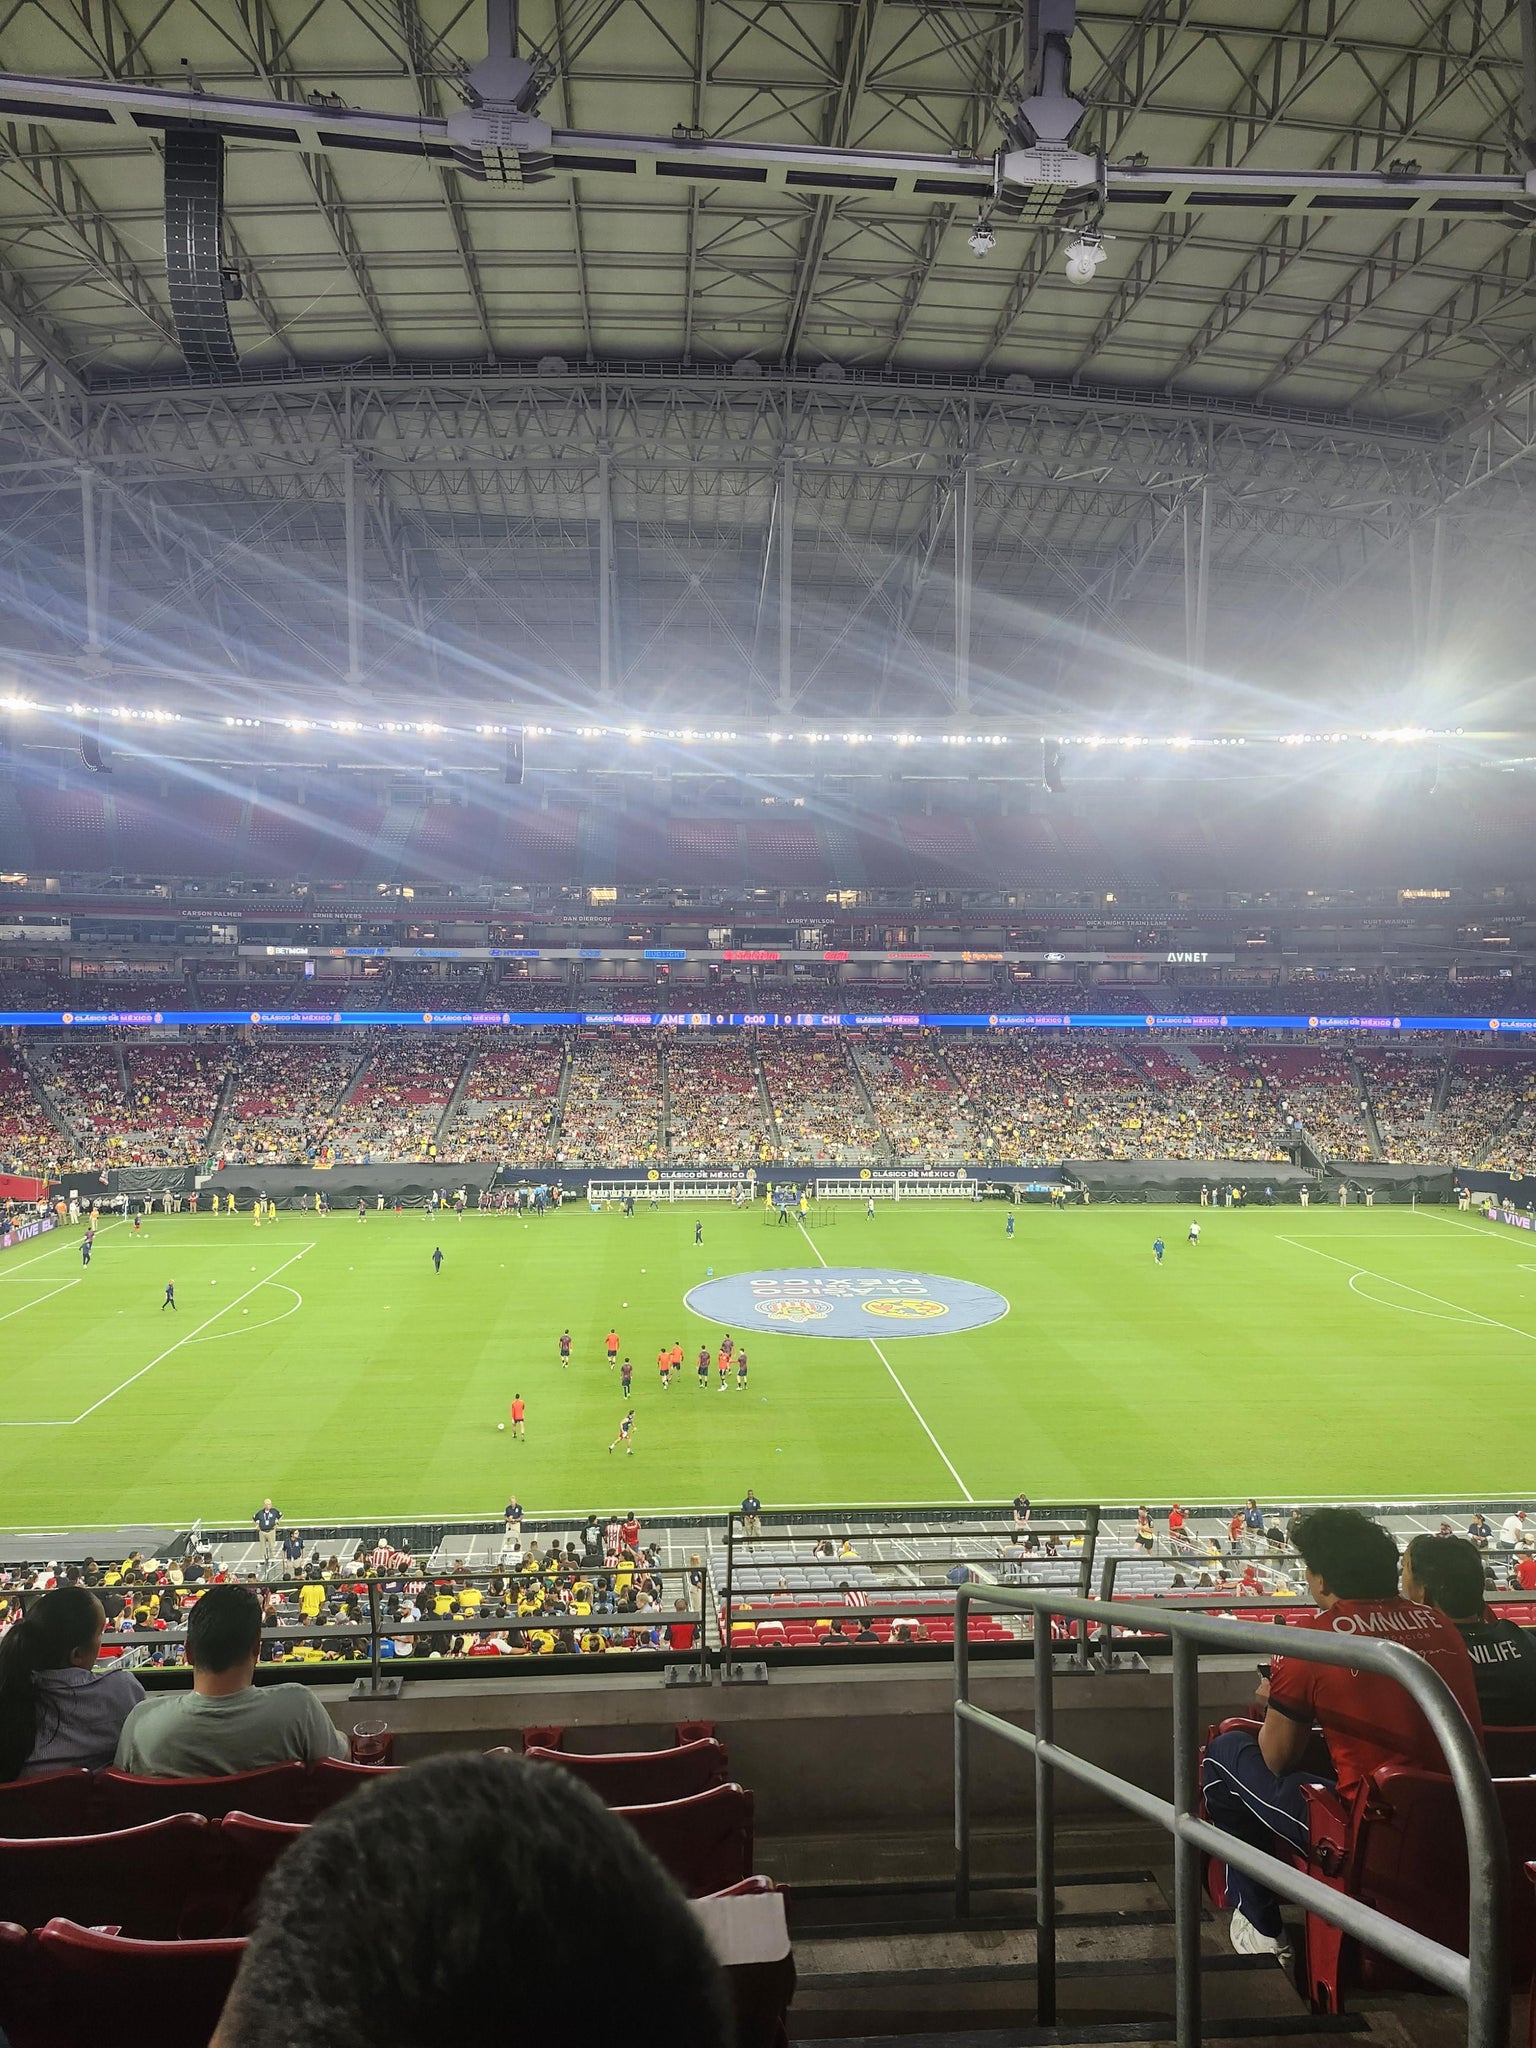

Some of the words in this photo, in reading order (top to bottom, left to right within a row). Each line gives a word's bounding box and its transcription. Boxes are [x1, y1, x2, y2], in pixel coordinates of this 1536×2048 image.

[275, 947, 308, 955] BETMGM
[1167, 952, 1209, 962] AVNET
[660, 1015, 685, 1024] AME
[716, 1015, 724, 1024] 0
[743, 1015, 766, 1024] 0:00
[784, 1015, 792, 1024] 0
[821, 1015, 840, 1024] CHI
[1504, 1212, 1531, 1229] VIVE
[17, 1223, 39, 1241] VIVE
[1332, 1608, 1443, 1635] OMNILIFE
[1467, 1639, 1522, 1664] NILIFE
